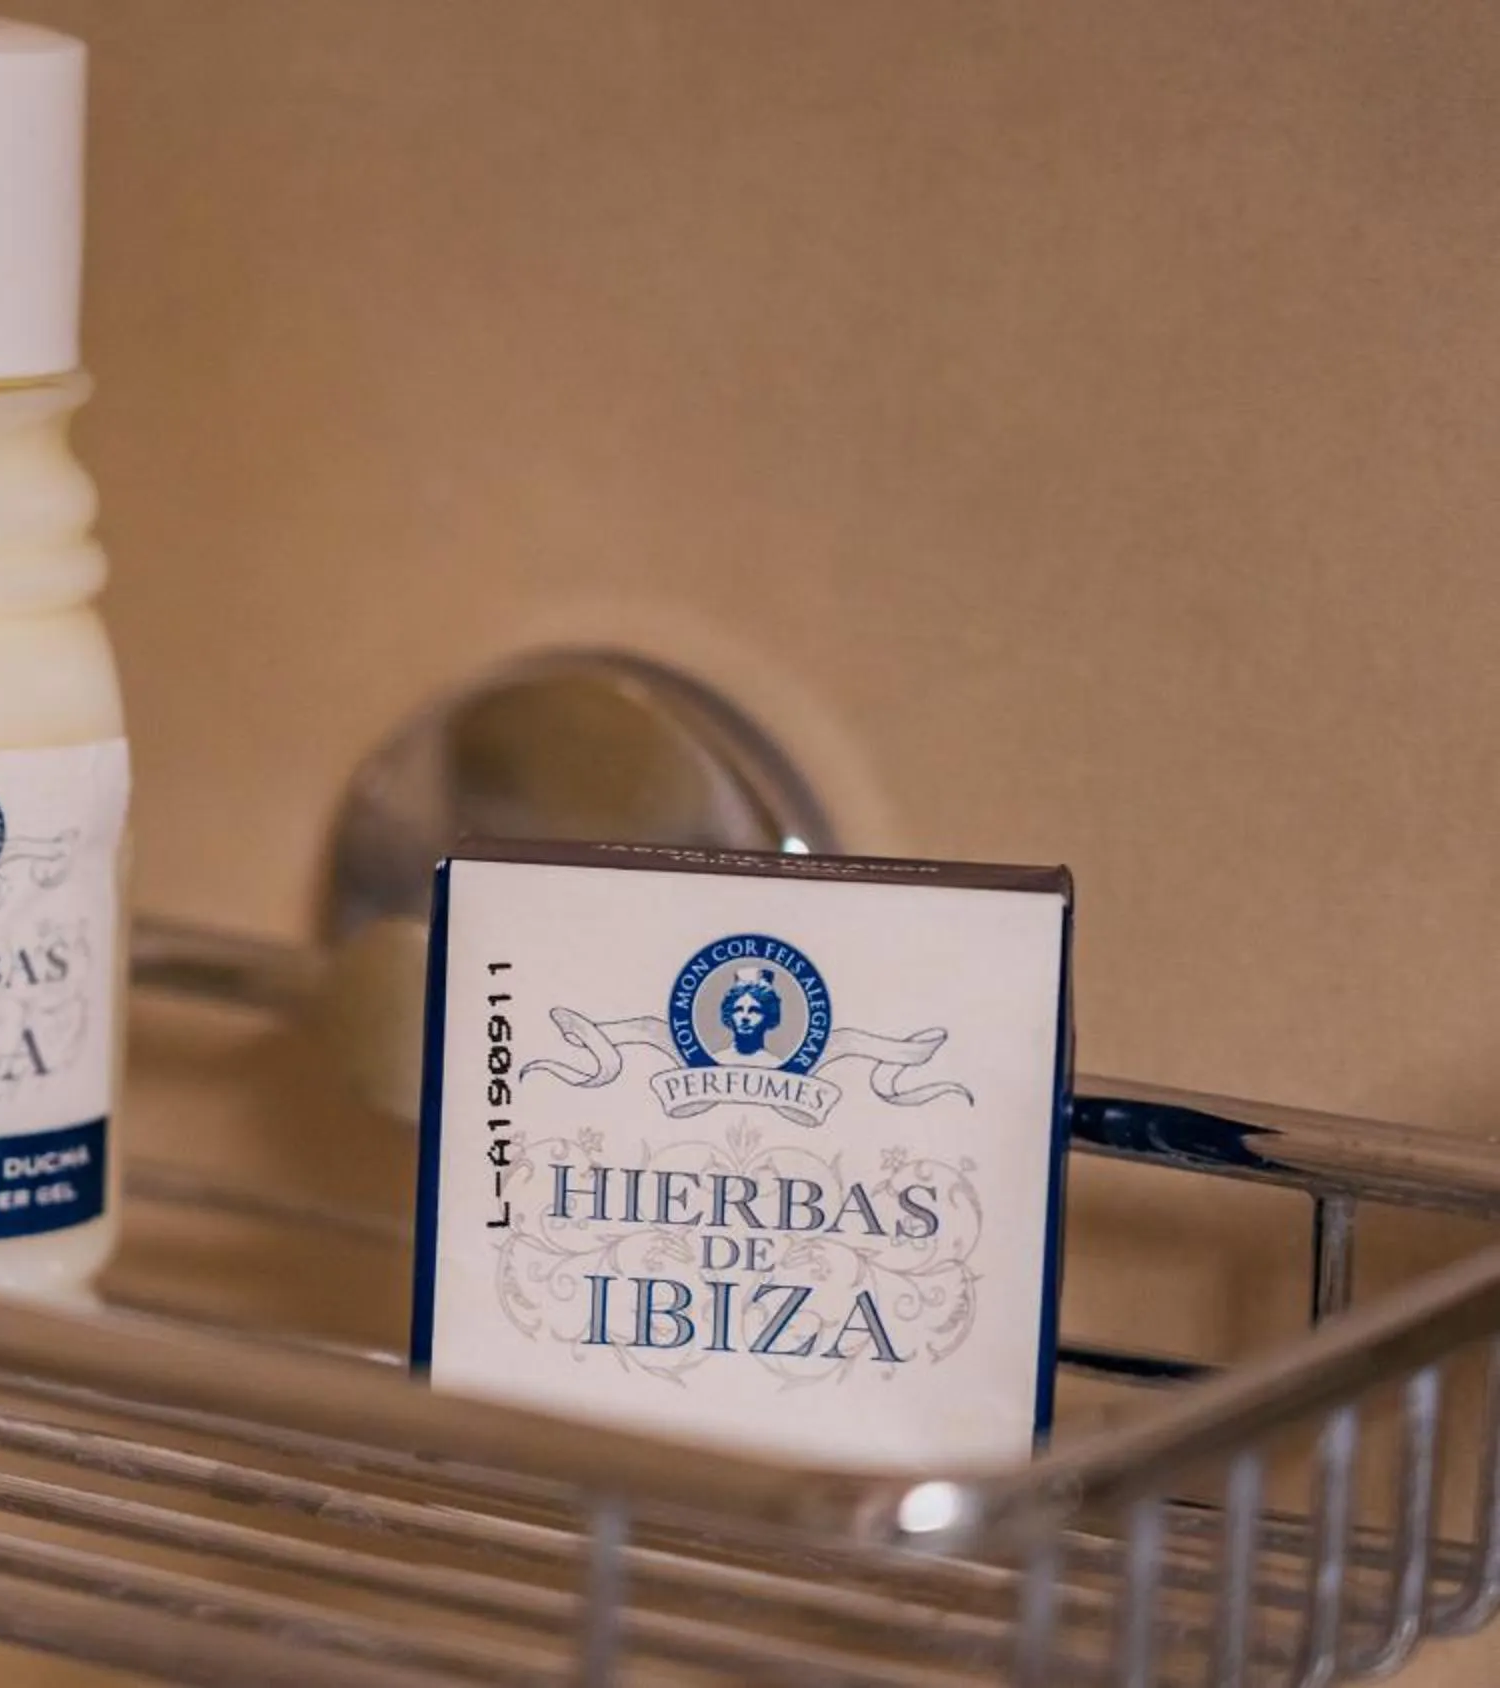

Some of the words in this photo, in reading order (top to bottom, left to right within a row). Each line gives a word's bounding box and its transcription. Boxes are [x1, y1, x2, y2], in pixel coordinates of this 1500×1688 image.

[711, 939, 758, 962] COR
[765, 942, 806, 975] FEIS
[676, 958, 709, 1009] MON
[674, 1018, 699, 1060] TOT
[794, 975, 828, 1068] ALEGRAR
[487, 963, 512, 1228] L-A190911
[664, 1071, 827, 1109] PERFUMES
[36, 1183, 78, 1205] GEL
[548, 1163, 940, 1240] HIERBAS
[701, 1234, 776, 1273] DE
[580, 1274, 910, 1364] IBIZA
